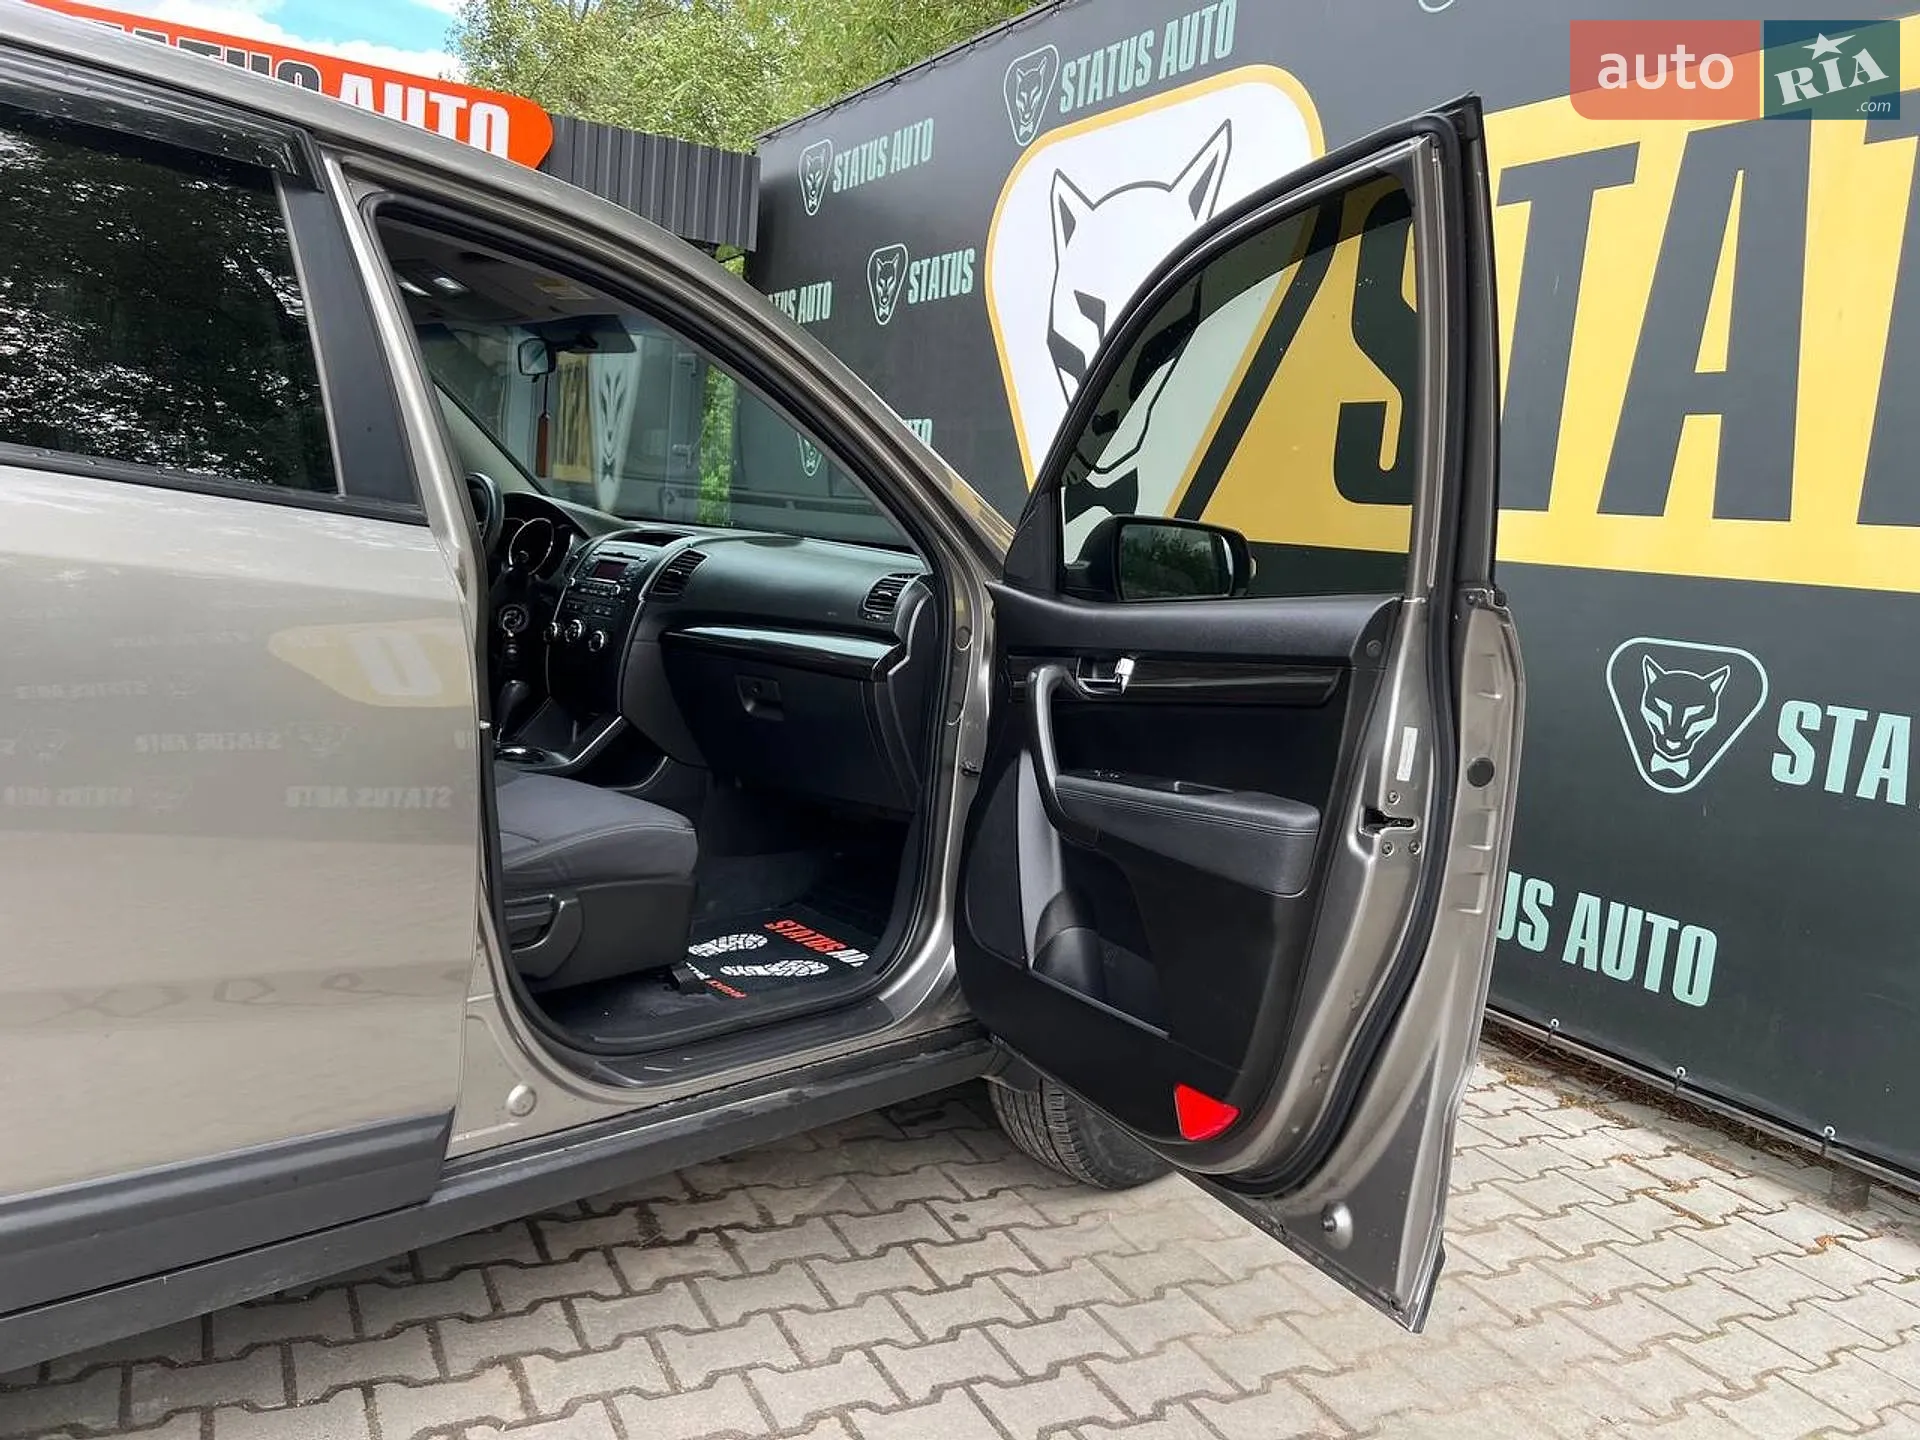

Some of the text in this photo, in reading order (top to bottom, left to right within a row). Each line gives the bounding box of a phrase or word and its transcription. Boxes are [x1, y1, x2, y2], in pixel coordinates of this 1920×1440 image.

[1059, 0, 1238, 114] STATUS AUTO
[832, 117, 935, 193] STATUS AUTO
[797, 280, 833, 324] AUTO
[907, 248, 975, 305] STATUS
[763, 918, 848, 954] STATUS
[1561, 892, 1718, 1008] AUTO
